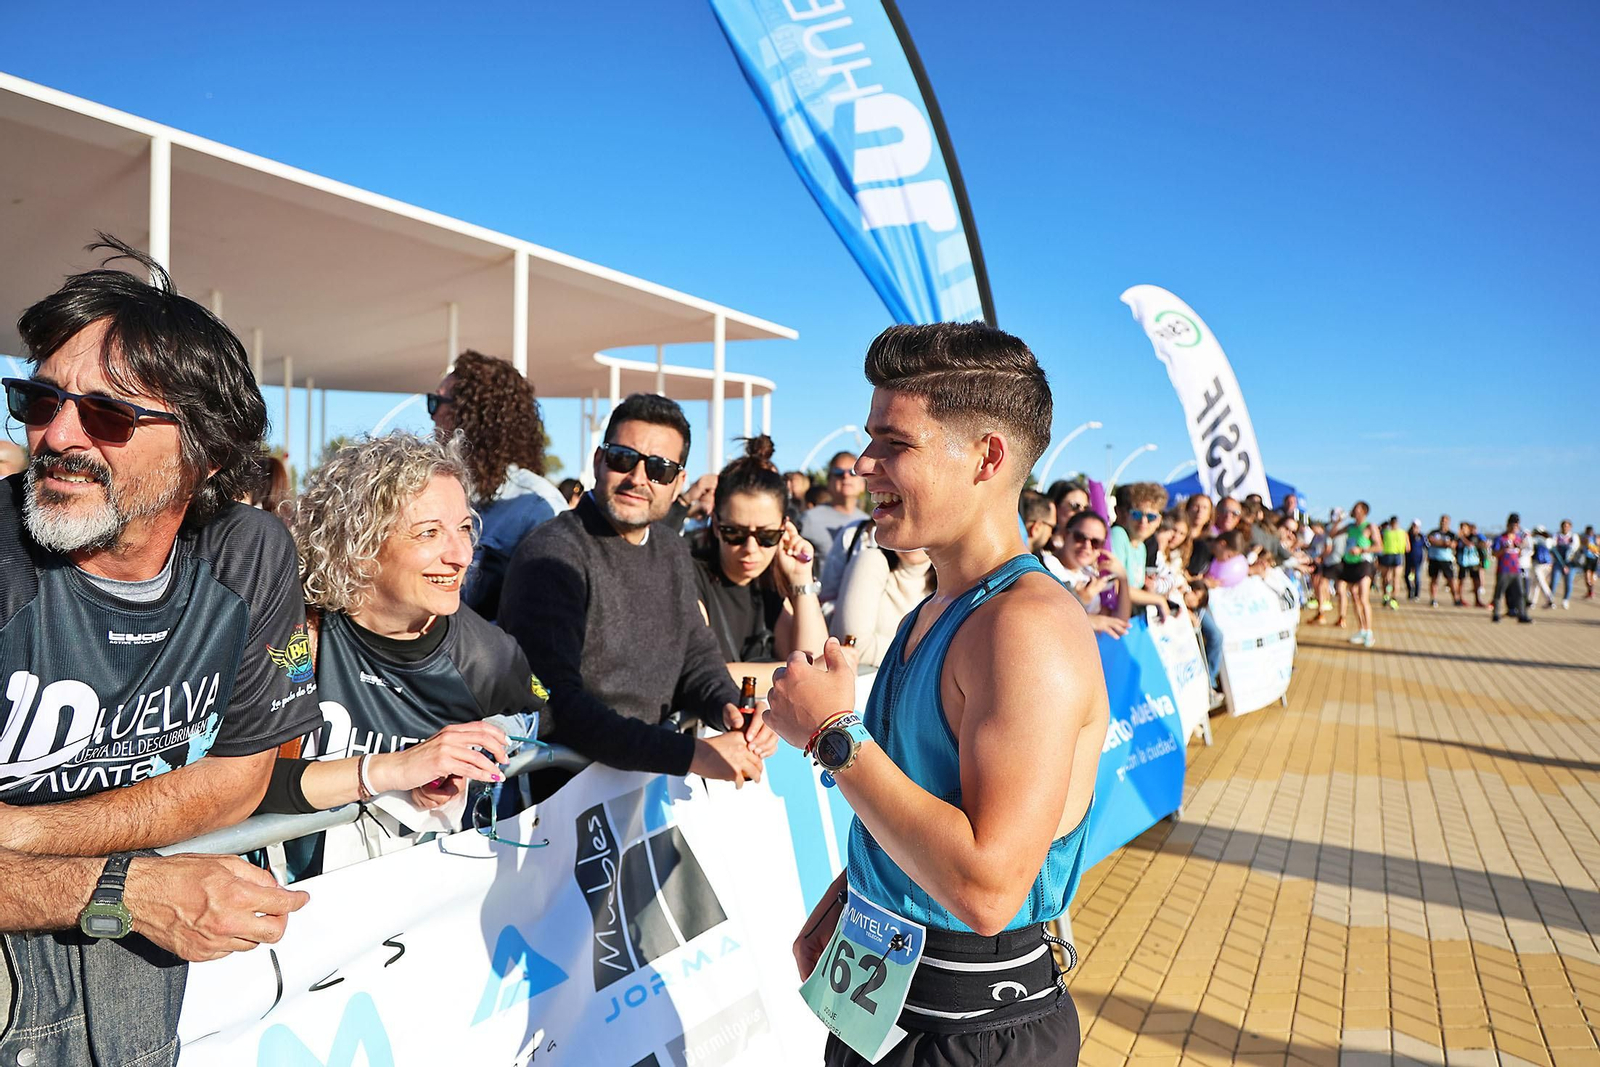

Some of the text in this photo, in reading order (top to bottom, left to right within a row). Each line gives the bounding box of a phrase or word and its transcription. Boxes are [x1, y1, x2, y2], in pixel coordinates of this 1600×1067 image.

[113, 741, 135, 756] DEL
[574, 814, 628, 971] Muebles
[847, 907, 883, 938] AVATEL
[865, 930, 883, 943] TELECOM
[604, 934, 741, 1024] JORMA
